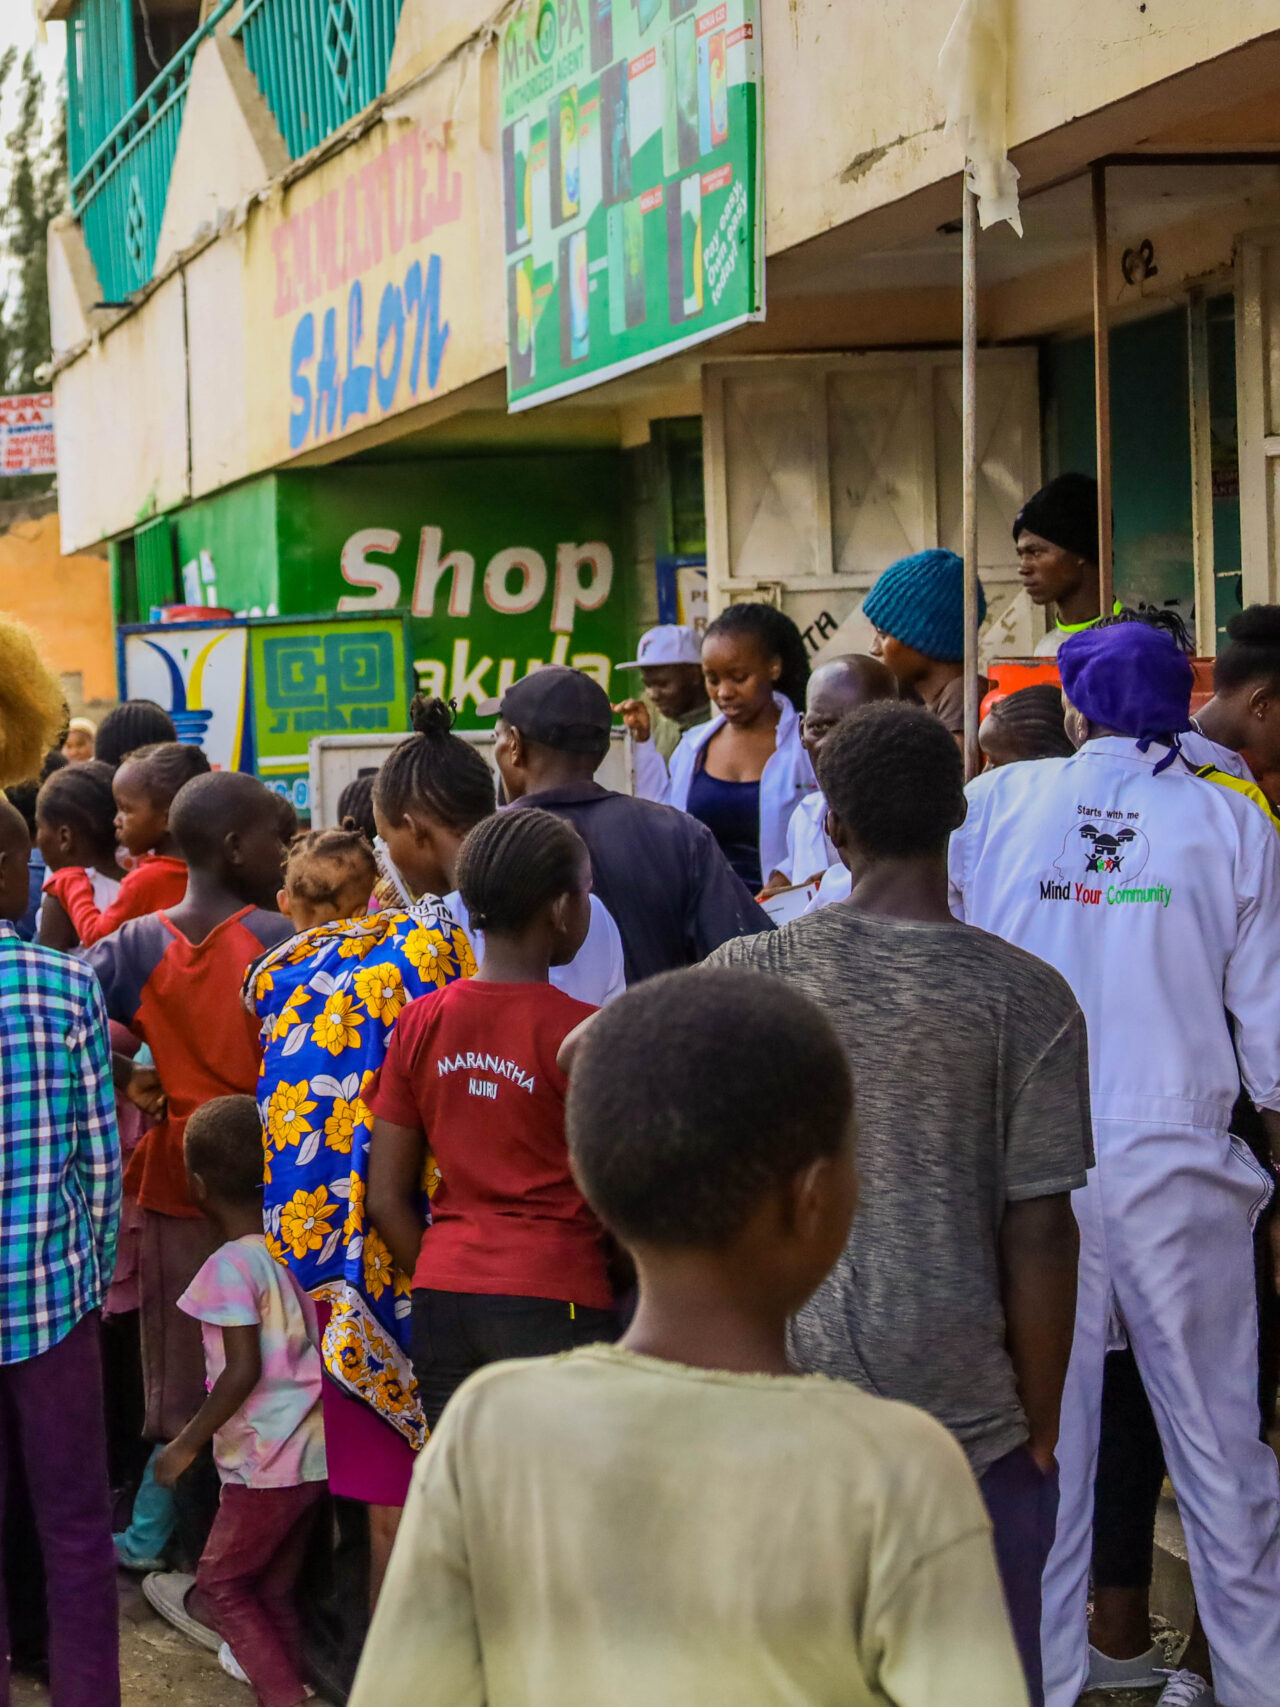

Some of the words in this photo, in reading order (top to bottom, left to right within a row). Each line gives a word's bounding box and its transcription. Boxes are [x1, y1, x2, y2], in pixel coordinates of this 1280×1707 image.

[557, 43, 584, 82] AGENT
[337, 526, 613, 633] Shop
[1077, 805, 1102, 818] Starts
[1106, 809, 1123, 820] with
[1127, 811, 1140, 820] me
[1040, 880, 1071, 901] Mind
[1075, 883, 1102, 905] Your
[1106, 883, 1172, 908] Community
[437, 1051, 536, 1095] MARANATHA
